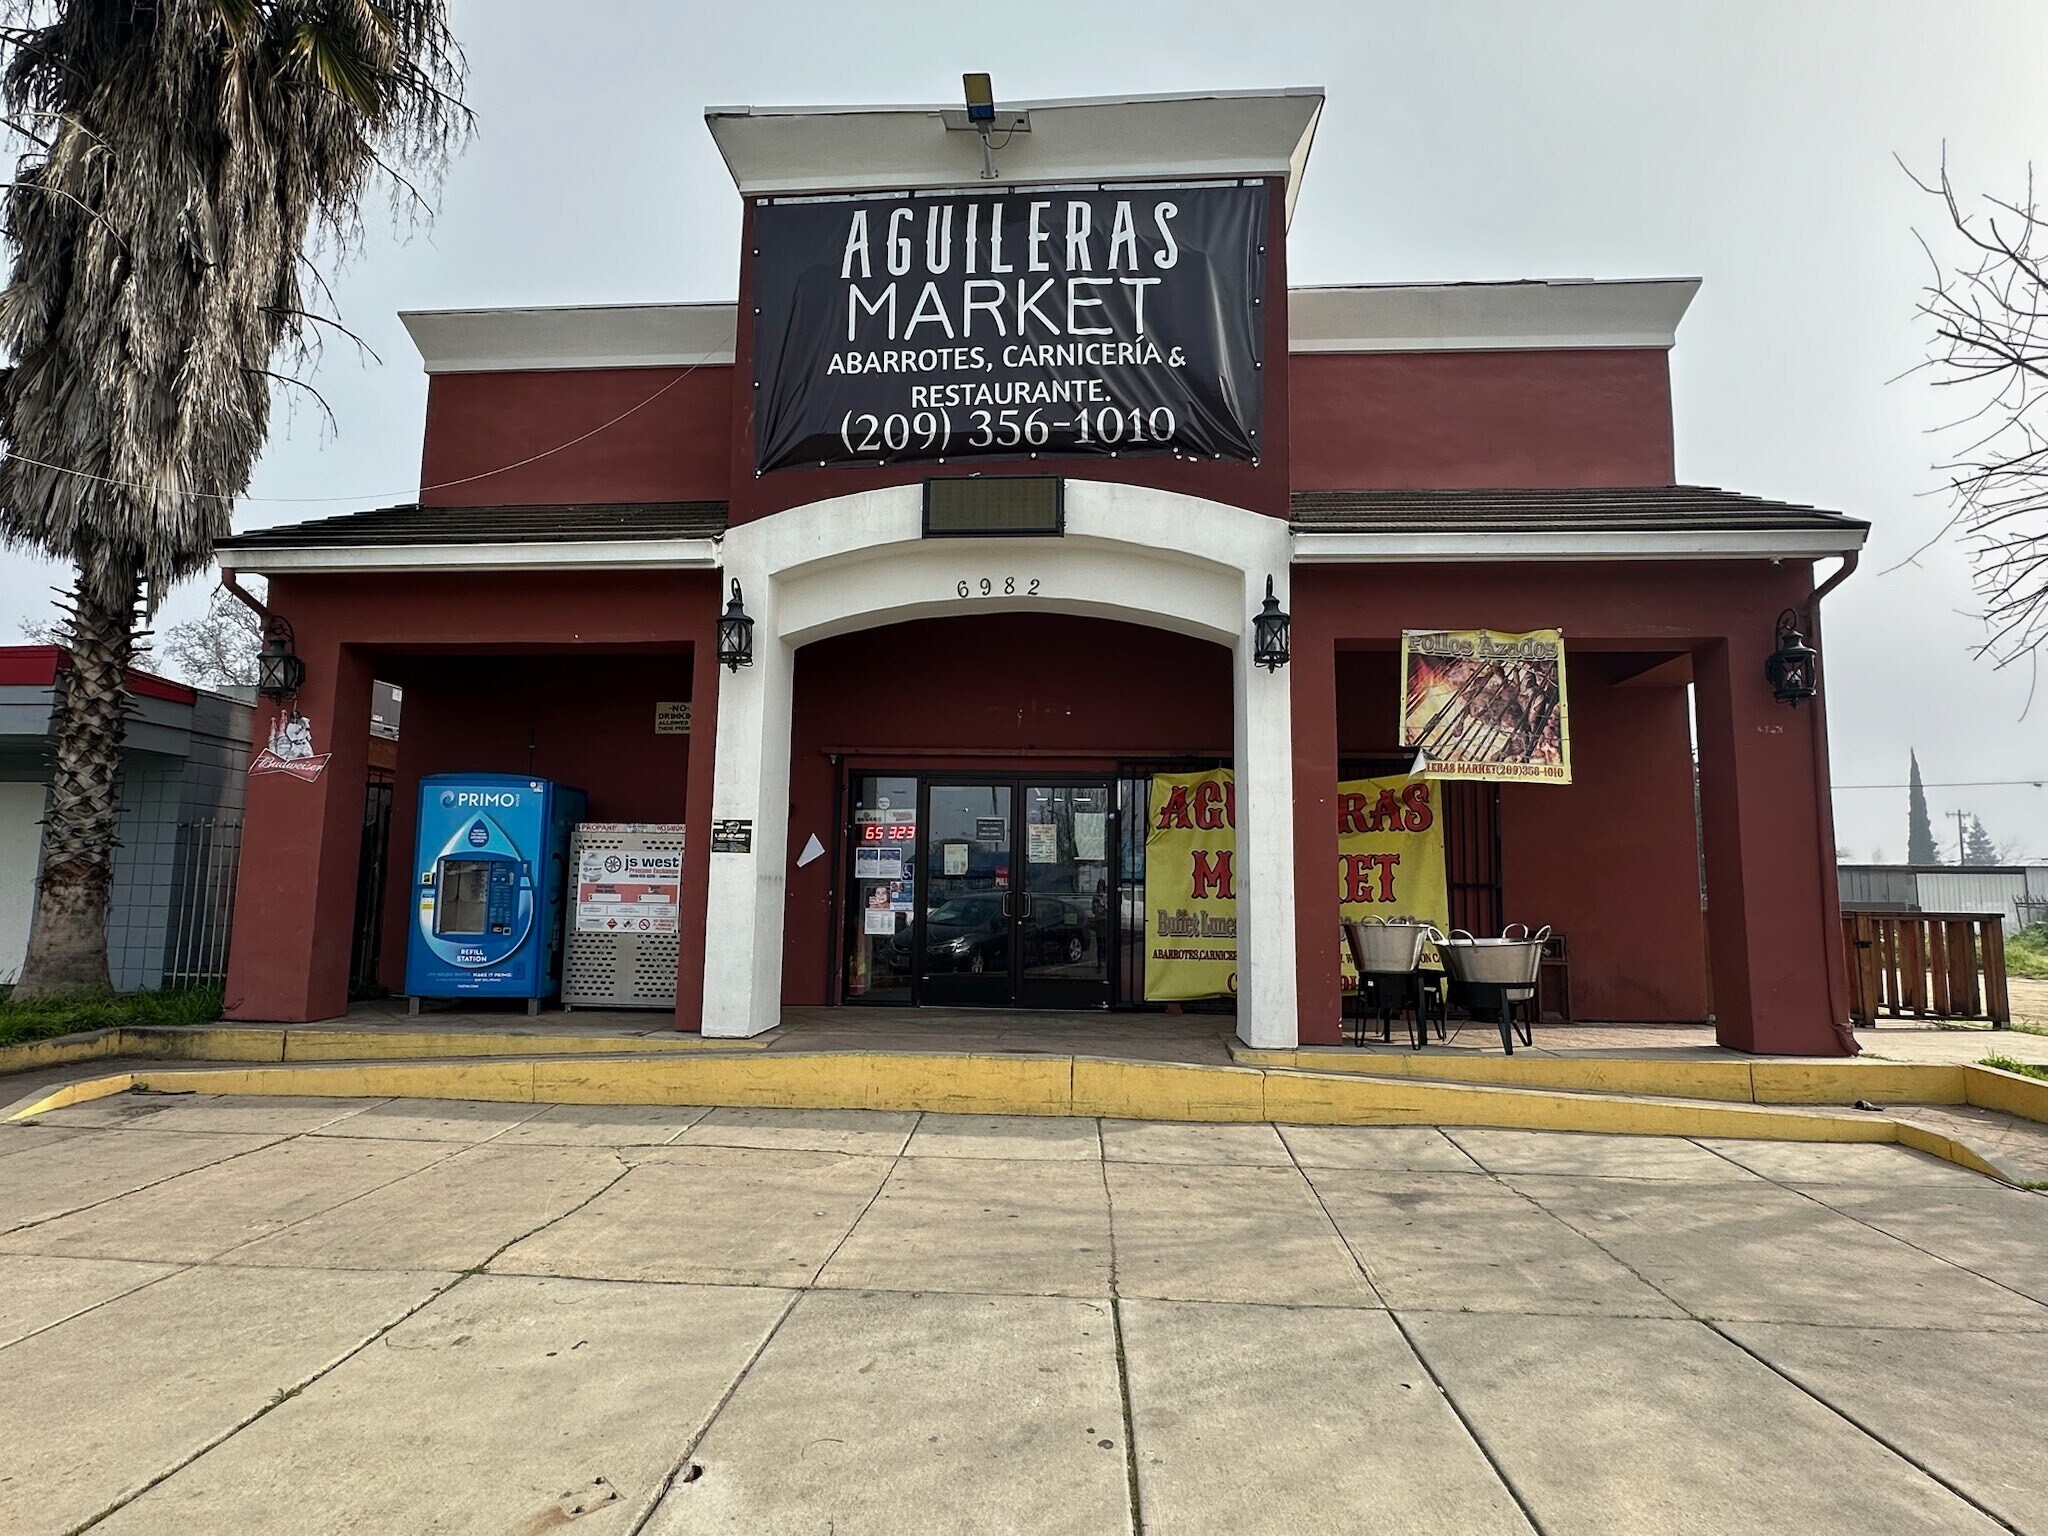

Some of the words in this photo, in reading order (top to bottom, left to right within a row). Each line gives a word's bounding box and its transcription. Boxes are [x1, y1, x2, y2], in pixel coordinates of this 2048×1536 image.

[840, 200, 1178, 279] AGUILERAS
[847, 277, 1161, 342] MARKET
[827, 347, 993, 375] ABARROTES,
[1002, 336, 1161, 367] CARNICERÍA
[1168, 348, 1186, 367] &
[911, 379, 1111, 409] RESTAURANTE.
[841, 408, 951, 453] (209)
[968, 406, 1176, 447] 356-1010
[957, 577, 1040, 597] 6982
[257, 755, 325, 772] Budweiser
[458, 793, 515, 807] PRIMO
[865, 826, 883, 839] 65
[888, 826, 916, 839] 323
[624, 854, 638, 871] js
[642, 856, 679, 868] west
